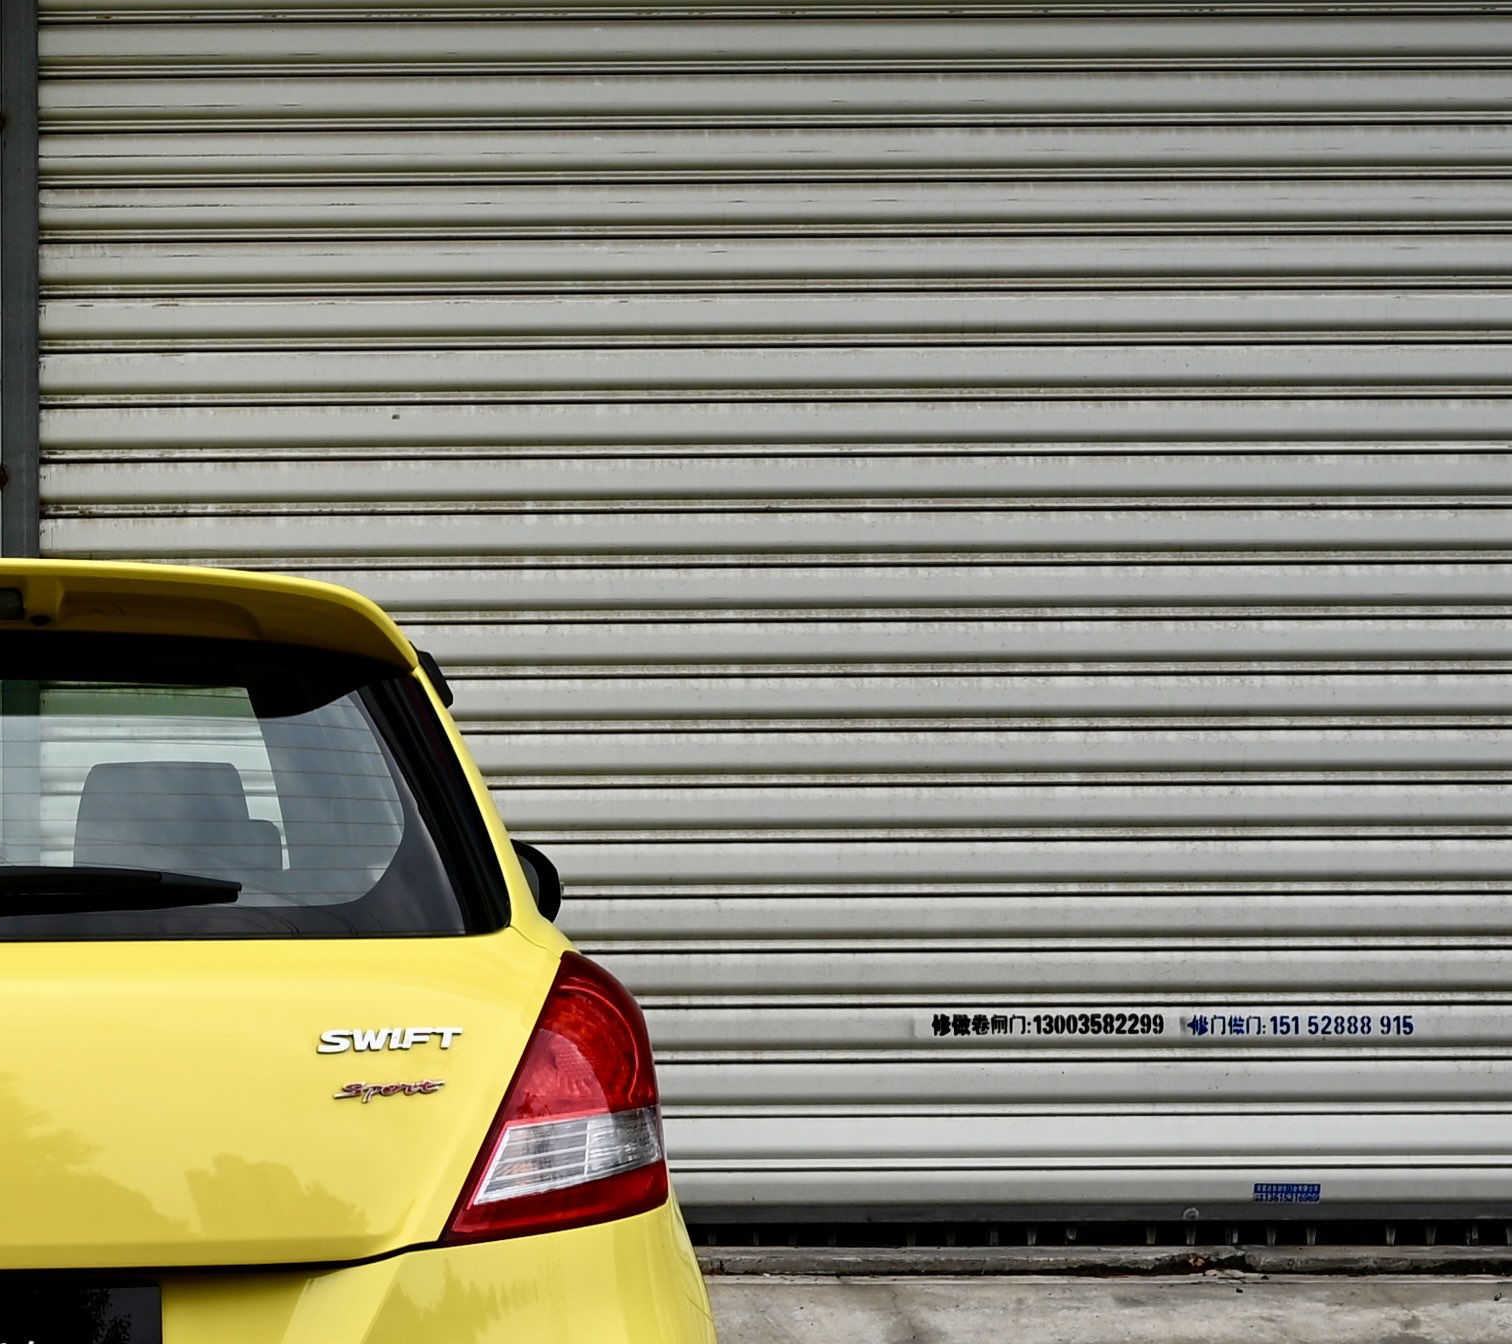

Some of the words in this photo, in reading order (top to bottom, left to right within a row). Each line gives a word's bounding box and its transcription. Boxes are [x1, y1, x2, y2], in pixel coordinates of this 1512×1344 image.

[1307, 1015, 1372, 1036] 52888
[1380, 1015, 1414, 1036] 915
[316, 1026, 464, 1054] SWIFT
[333, 1079, 446, 1103] Sport
